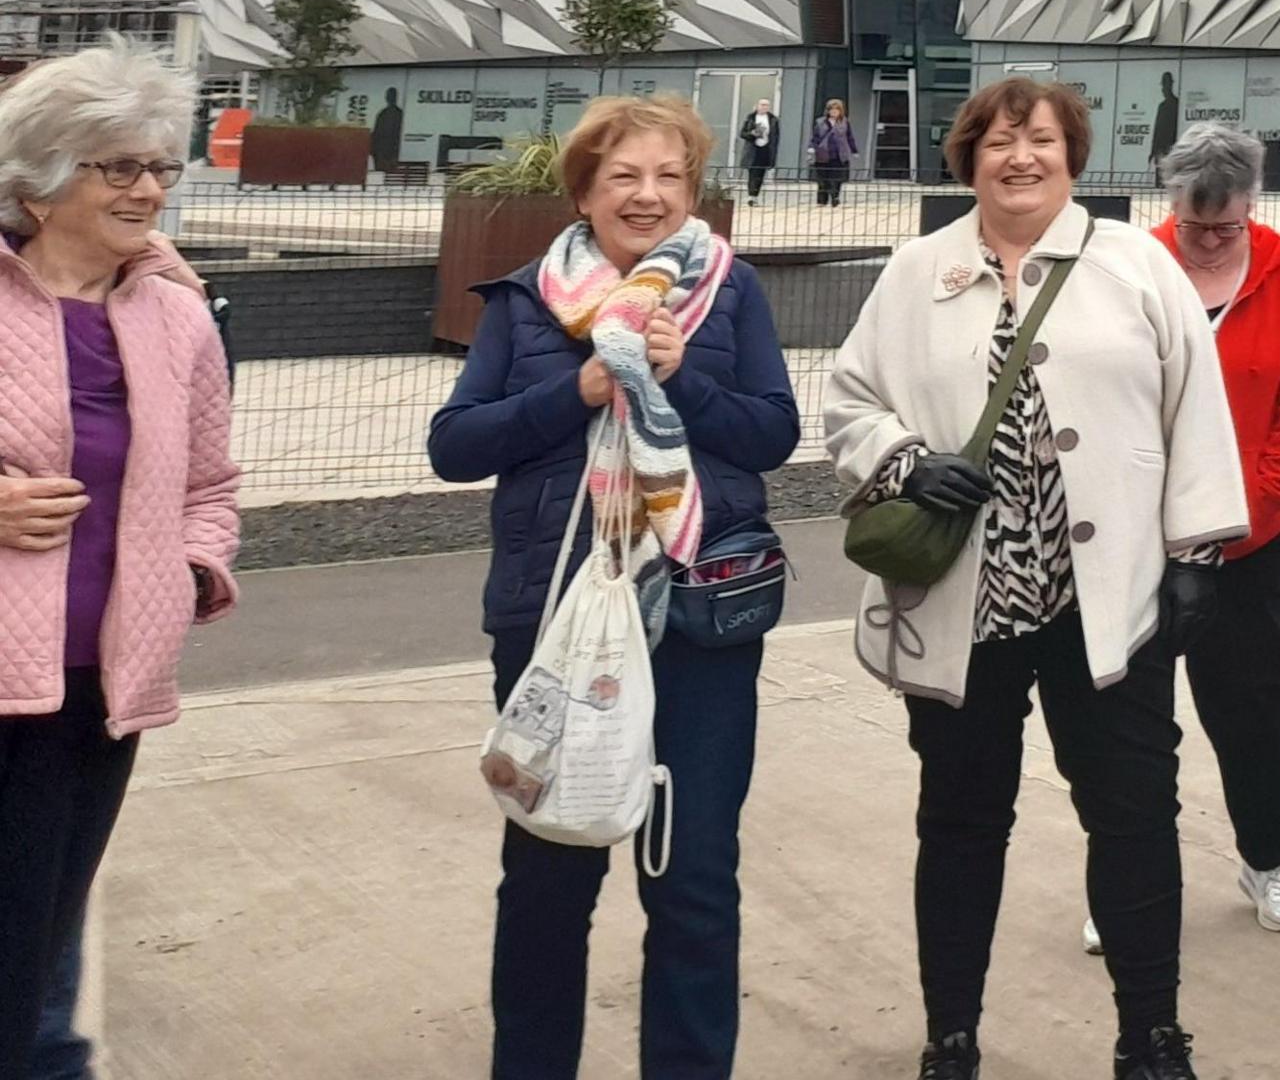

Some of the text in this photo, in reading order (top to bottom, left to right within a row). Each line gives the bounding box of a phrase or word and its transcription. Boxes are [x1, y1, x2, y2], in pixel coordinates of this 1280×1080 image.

[417, 90, 473, 104] SKILLED
[475, 97, 537, 109] DESIGNING
[474, 110, 507, 122] SHIPS
[1185, 108, 1240, 121] LUXURIOUS
[1124, 124, 1151, 135] BRUCE
[726, 602, 772, 629] SPORT
